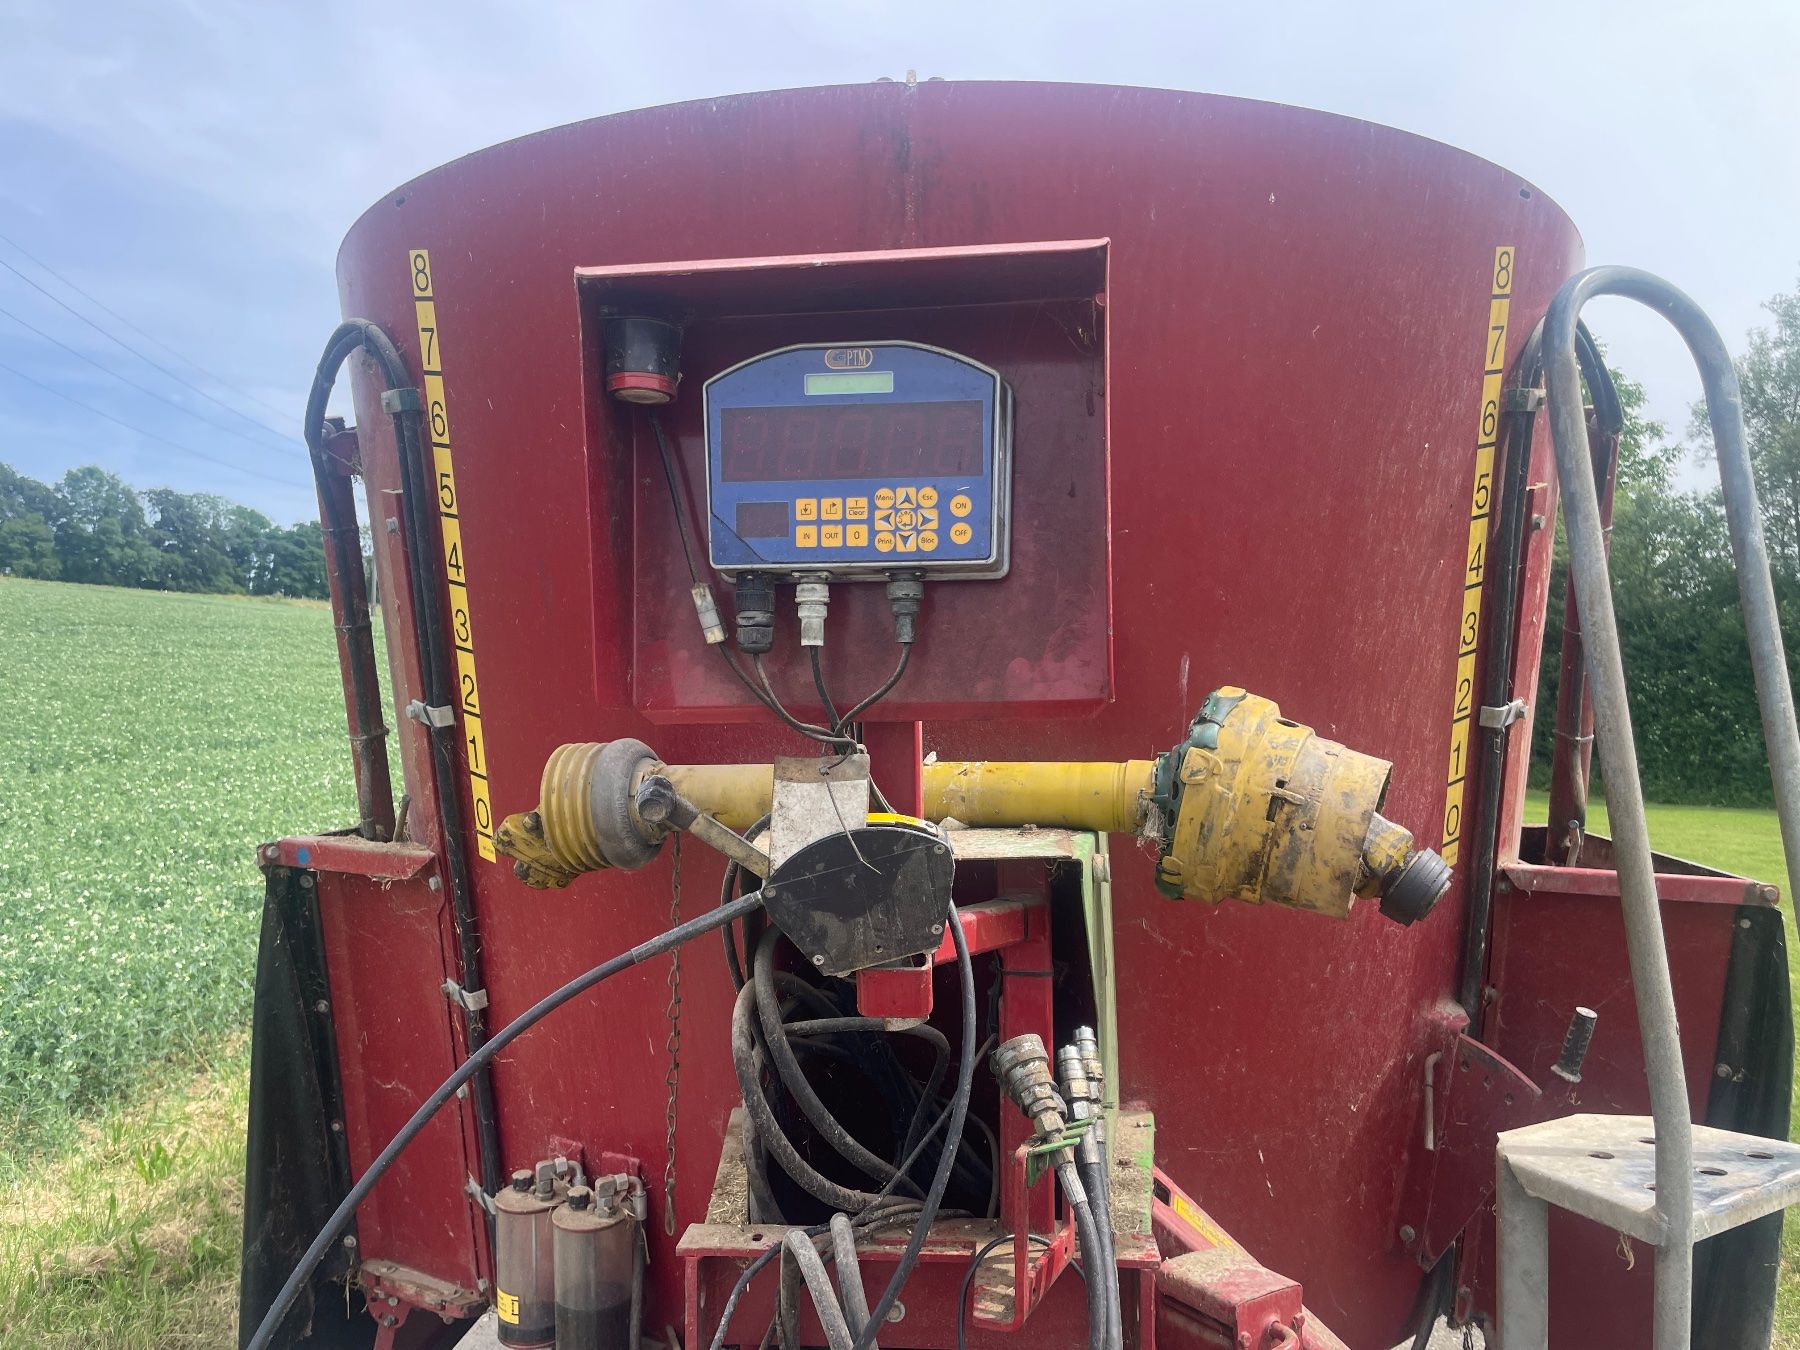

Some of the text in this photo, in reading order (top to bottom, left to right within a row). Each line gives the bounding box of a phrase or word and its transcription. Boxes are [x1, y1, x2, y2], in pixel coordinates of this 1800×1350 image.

[414, 254, 429, 292] 8
[1496, 251, 1511, 289] 8
[421, 327, 434, 365] 7
[1491, 325, 1505, 364] 7
[431, 400, 446, 437] 6
[1482, 400, 1497, 437] 6
[440, 473, 454, 509] 5
[1475, 472, 1490, 510] 5
[803, 532, 811, 540] IN
[824, 532, 839, 540] OUT
[448, 542, 462, 577] 4
[1468, 542, 1482, 578] 4
[455, 609, 469, 643] 3
[1462, 611, 1477, 647] 3
[462, 674, 477, 708] 2
[1457, 678, 1470, 714] 2
[469, 736, 478, 769] 1
[1453, 741, 1462, 776] 1
[476, 798, 490, 830] 0
[1446, 804, 1459, 837] 0
